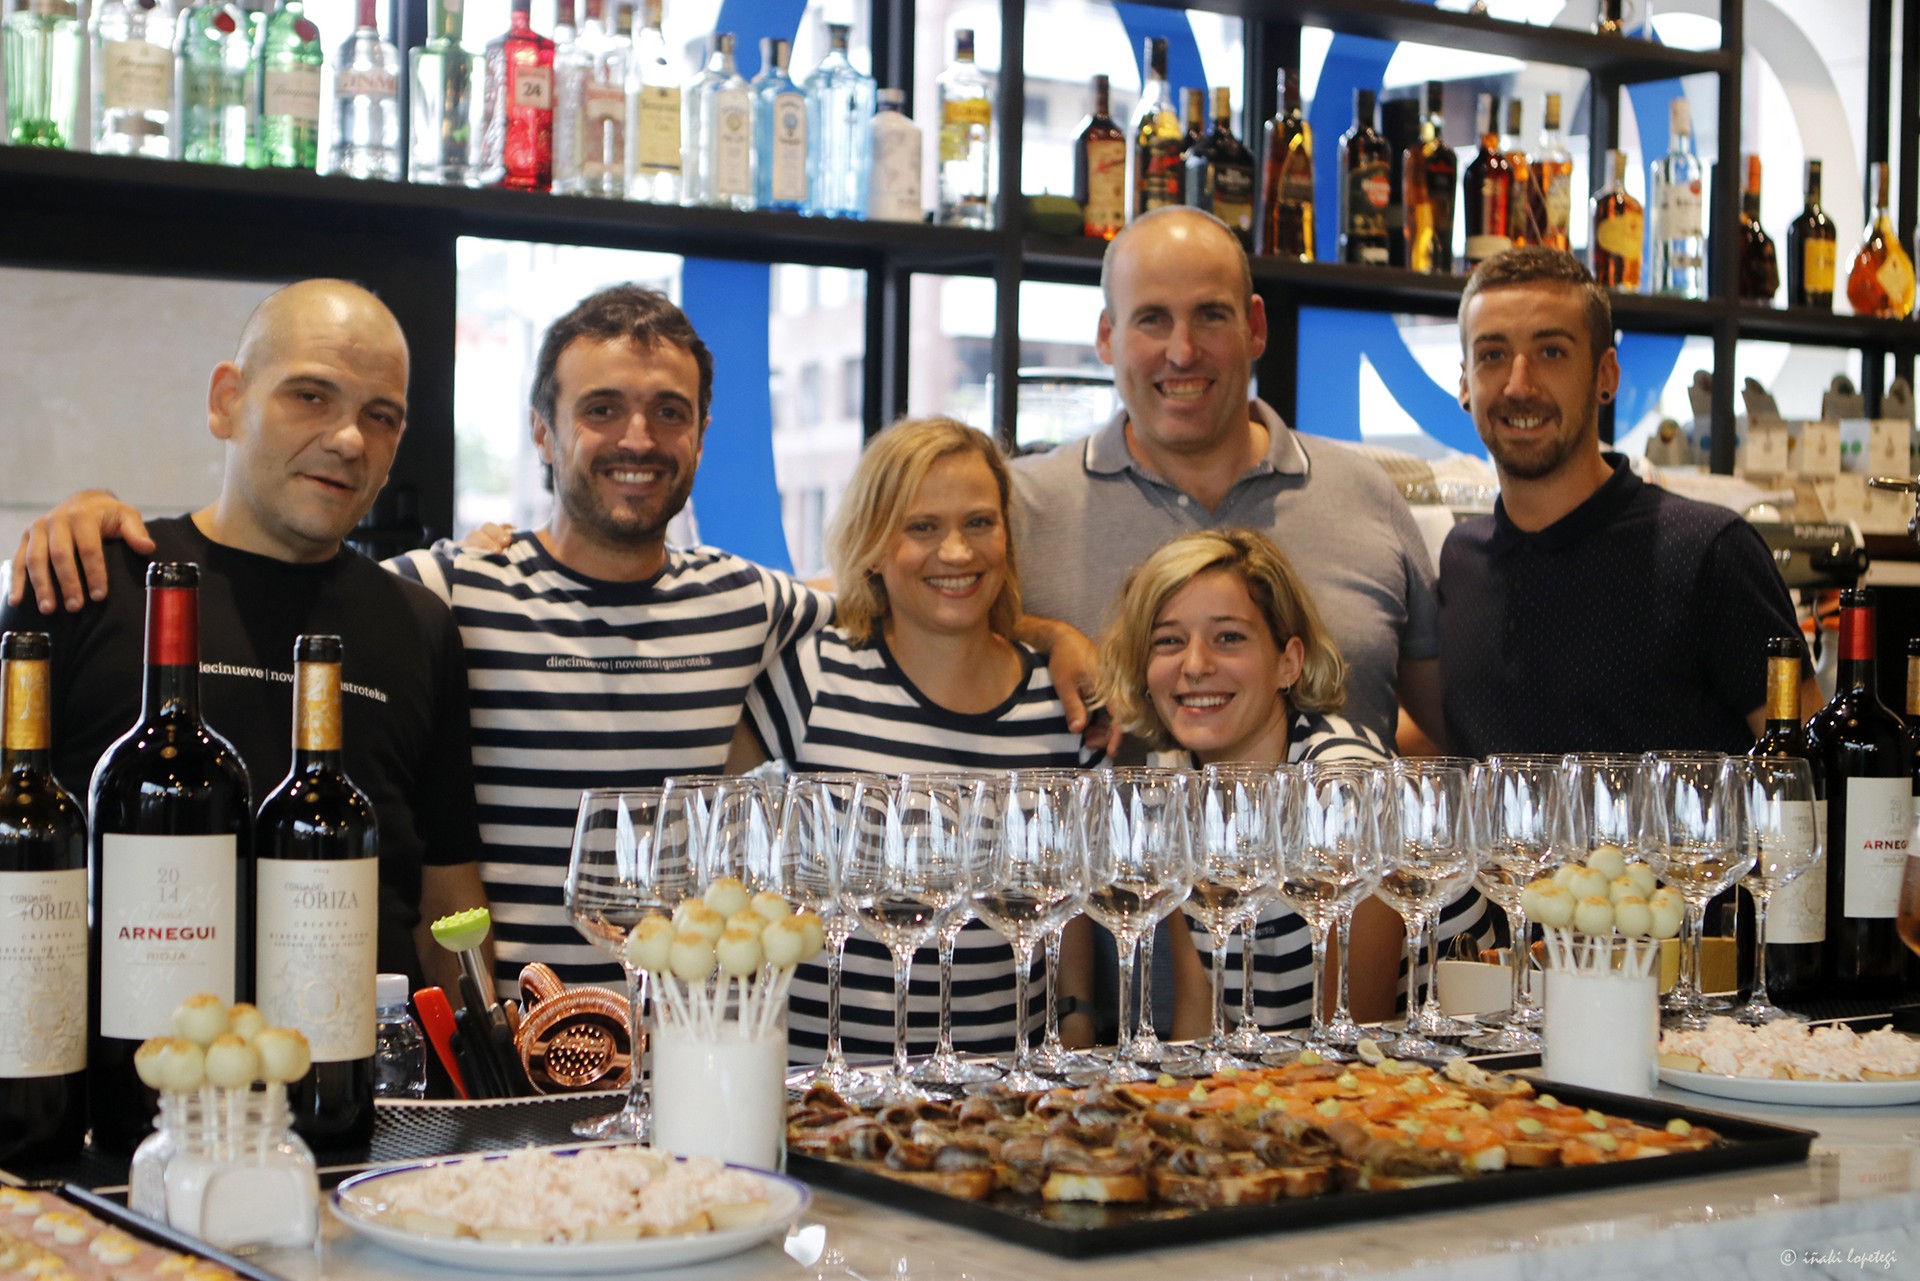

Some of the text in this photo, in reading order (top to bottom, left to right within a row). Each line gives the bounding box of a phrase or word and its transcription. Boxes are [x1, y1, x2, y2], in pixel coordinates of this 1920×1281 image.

[522, 81, 542, 97] 24
[199, 661, 264, 679] iecinueve
[341, 680, 387, 703] stroteka
[1863, 839, 1908, 850] ARNEG
[157, 867, 180, 885] 20
[160, 886, 178, 903] 14
[118, 926, 217, 941] ARNEGUI
[146, 952, 187, 961] RIOJA
